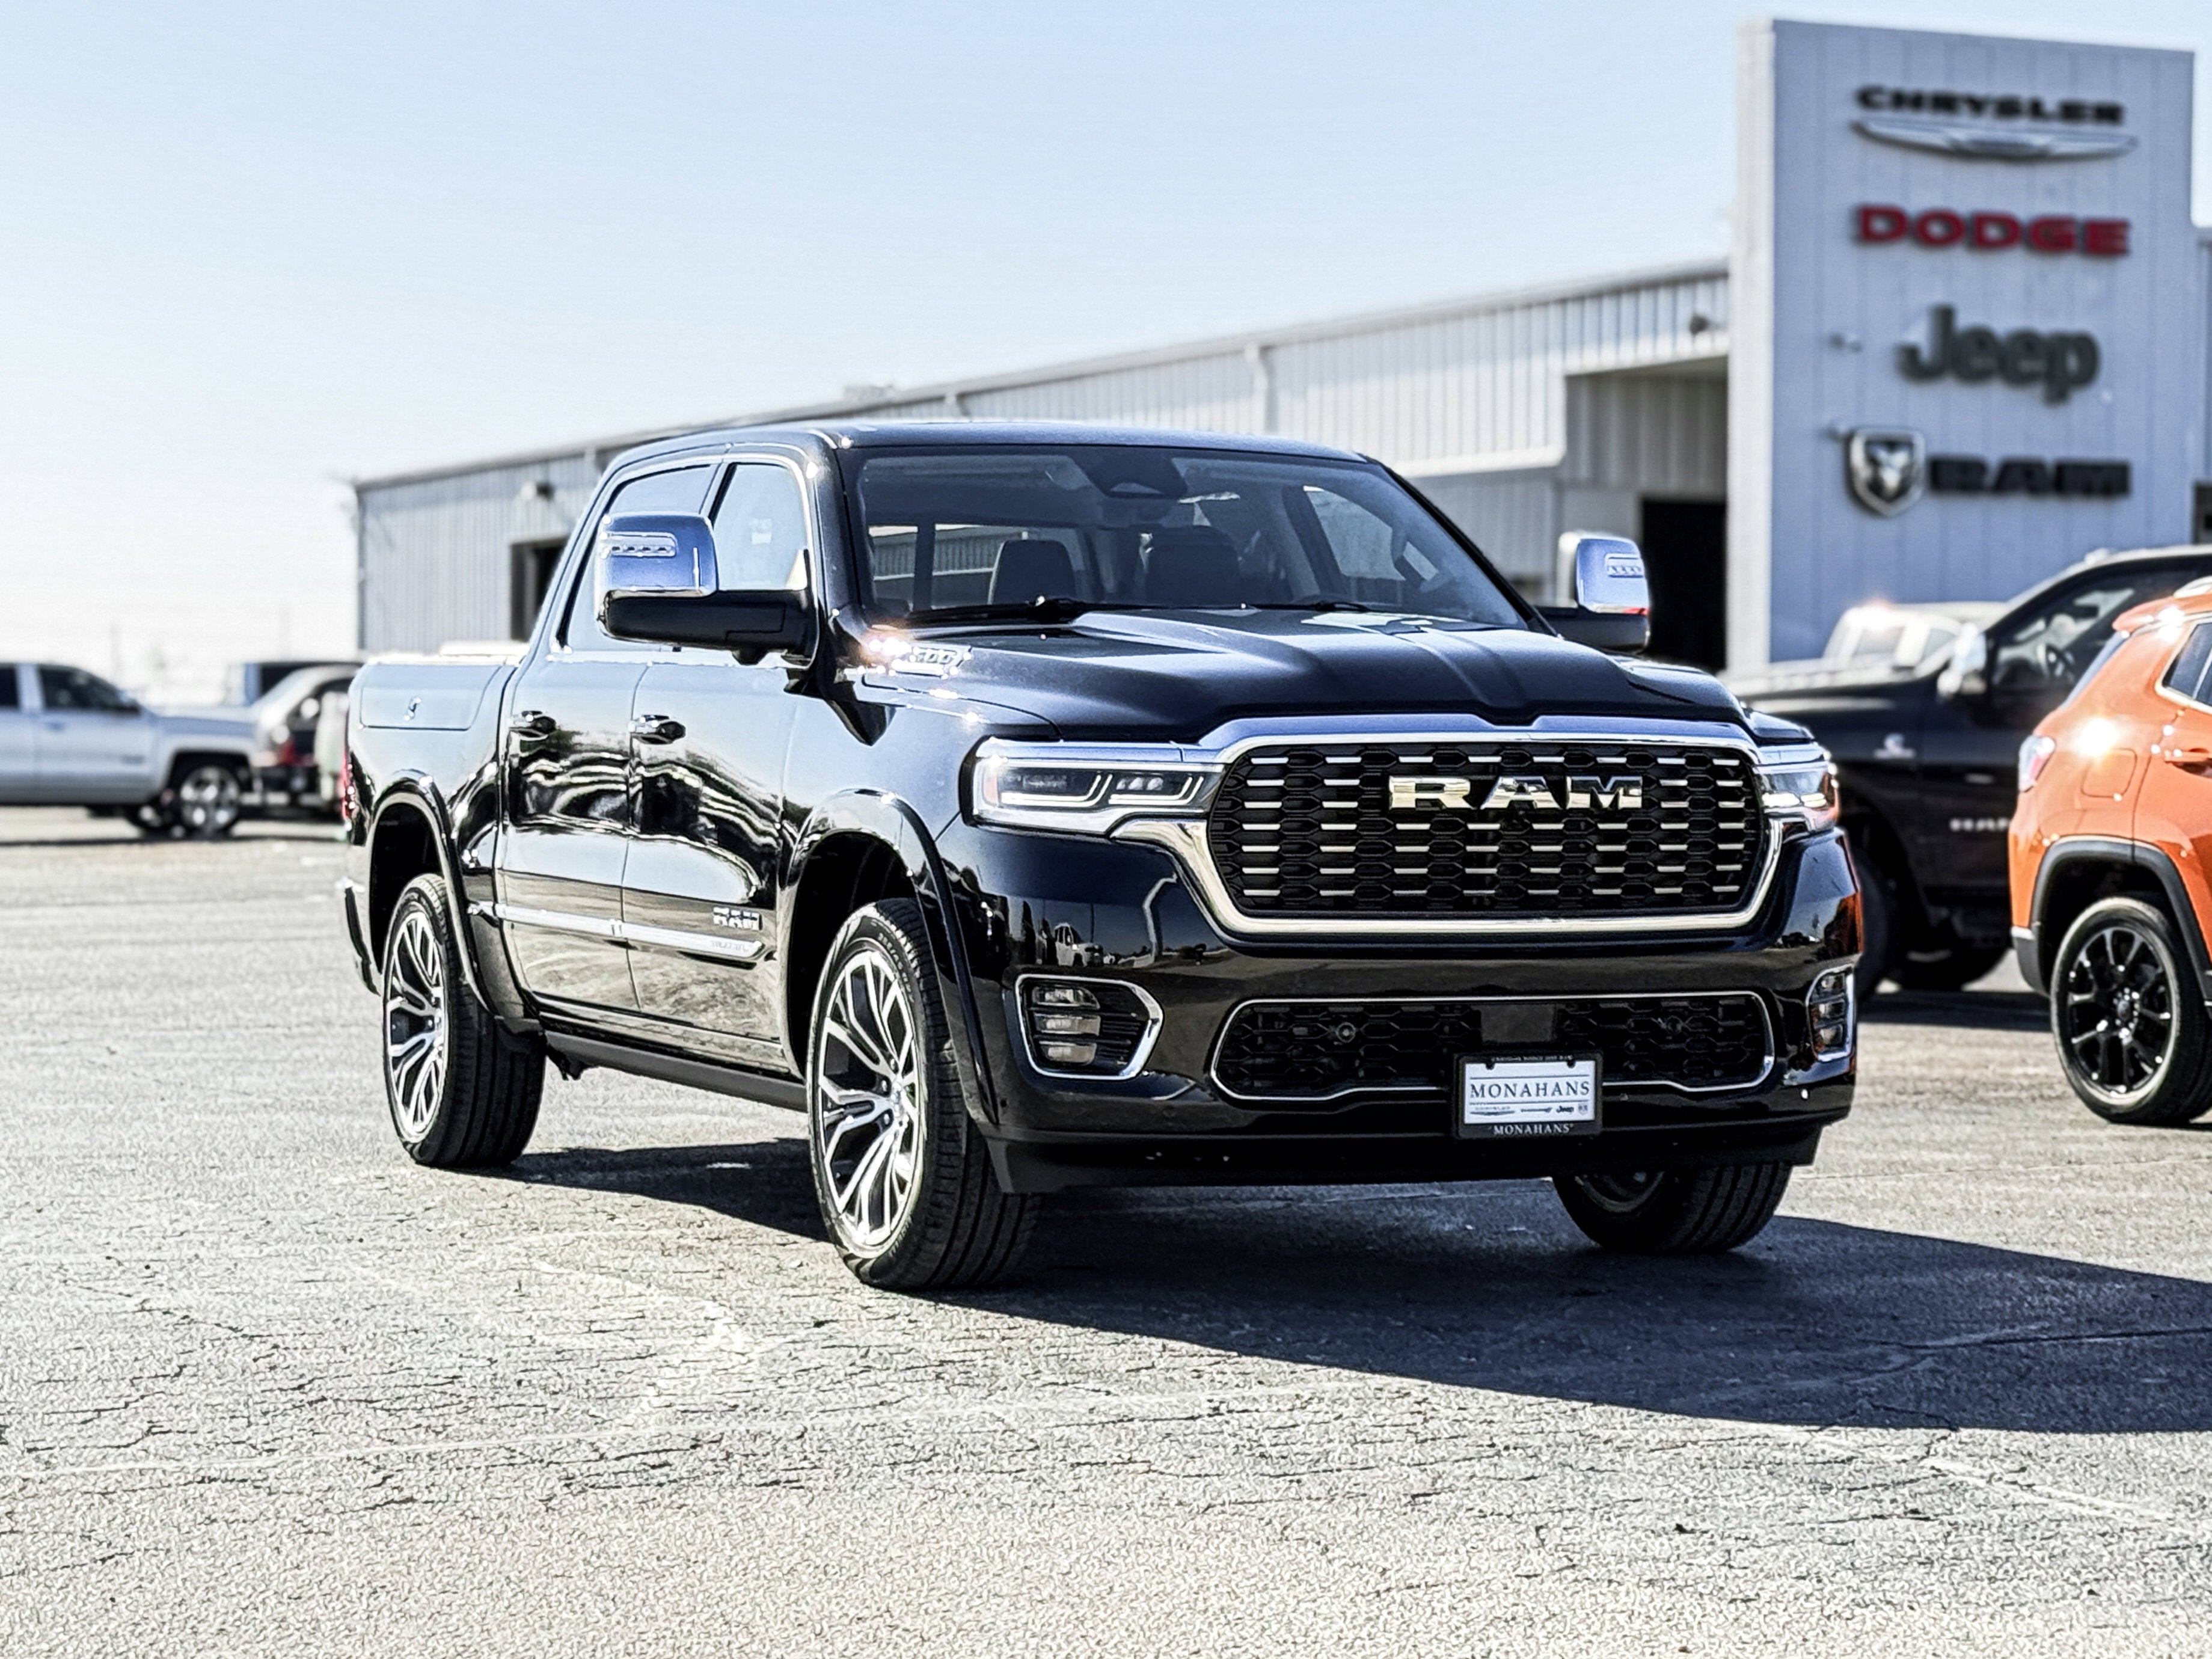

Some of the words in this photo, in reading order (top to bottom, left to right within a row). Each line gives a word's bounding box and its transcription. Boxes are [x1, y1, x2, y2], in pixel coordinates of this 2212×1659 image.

[1855, 86, 2125, 124] CHRYSLER
[1855, 205, 2130, 257] DODGE
[1897, 305, 2101, 406] Jeep
[1930, 456, 2131, 497] RAM
[1389, 776, 1642, 811] RAM
[712, 906, 760, 931] RAM
[1471, 1081, 1590, 1099] MONAHANS
